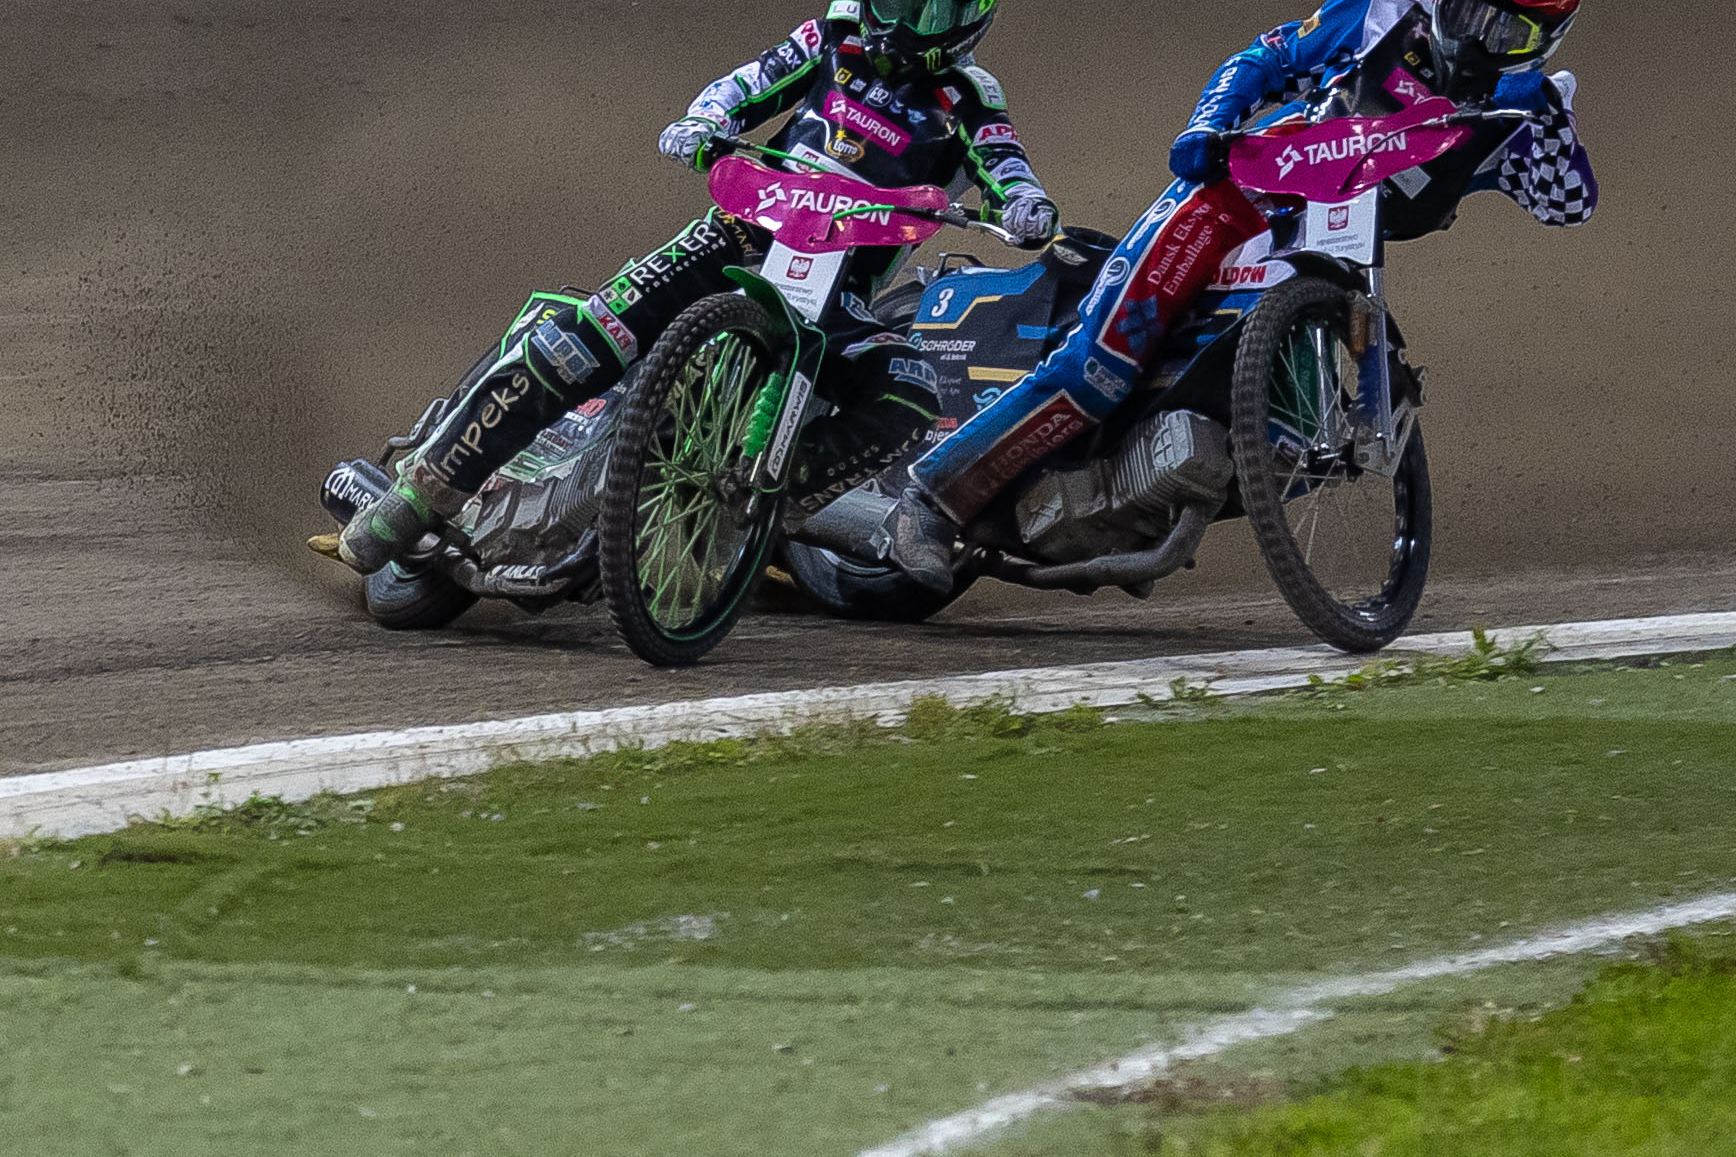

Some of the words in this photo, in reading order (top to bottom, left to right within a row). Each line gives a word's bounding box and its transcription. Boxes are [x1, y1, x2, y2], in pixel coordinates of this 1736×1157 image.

[869, 86, 889, 104] 692
[846, 106, 901, 147] TAURON
[833, 140, 858, 155] LOTTO
[1303, 130, 1407, 166] TAURON
[789, 188, 891, 226] TAURON
[630, 223, 718, 286] REXER
[1147, 242, 1181, 286] Dansk
[1162, 235, 1214, 297] Emballage
[931, 287, 954, 319] 3
